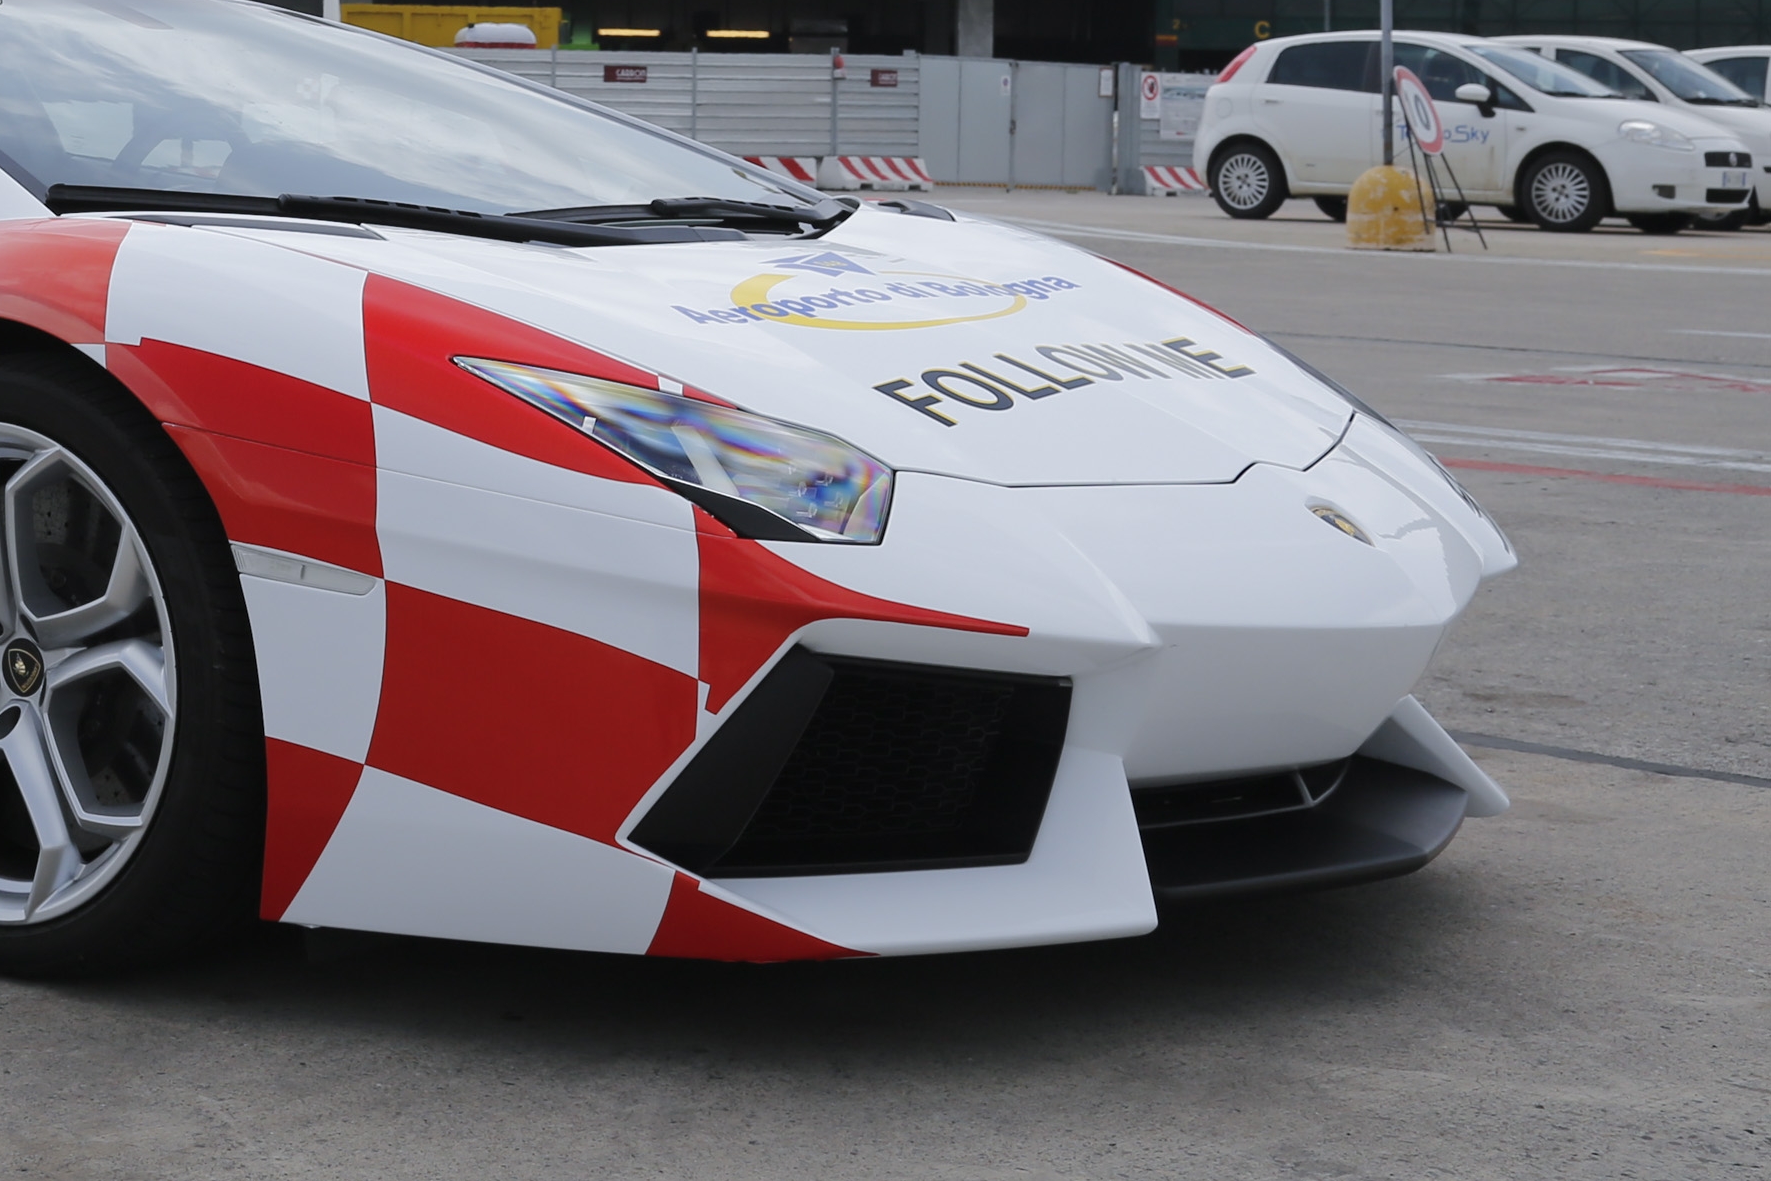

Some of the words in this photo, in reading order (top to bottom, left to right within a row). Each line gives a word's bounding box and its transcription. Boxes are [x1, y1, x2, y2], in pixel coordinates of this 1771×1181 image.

[1254, 20, 1271, 39] C
[670, 287, 892, 324] Aeroporto
[884, 282, 939, 299] di
[916, 275, 1082, 301] Bologna
[871, 342, 1173, 428] FOLLOW
[1122, 336, 1257, 379] ME
